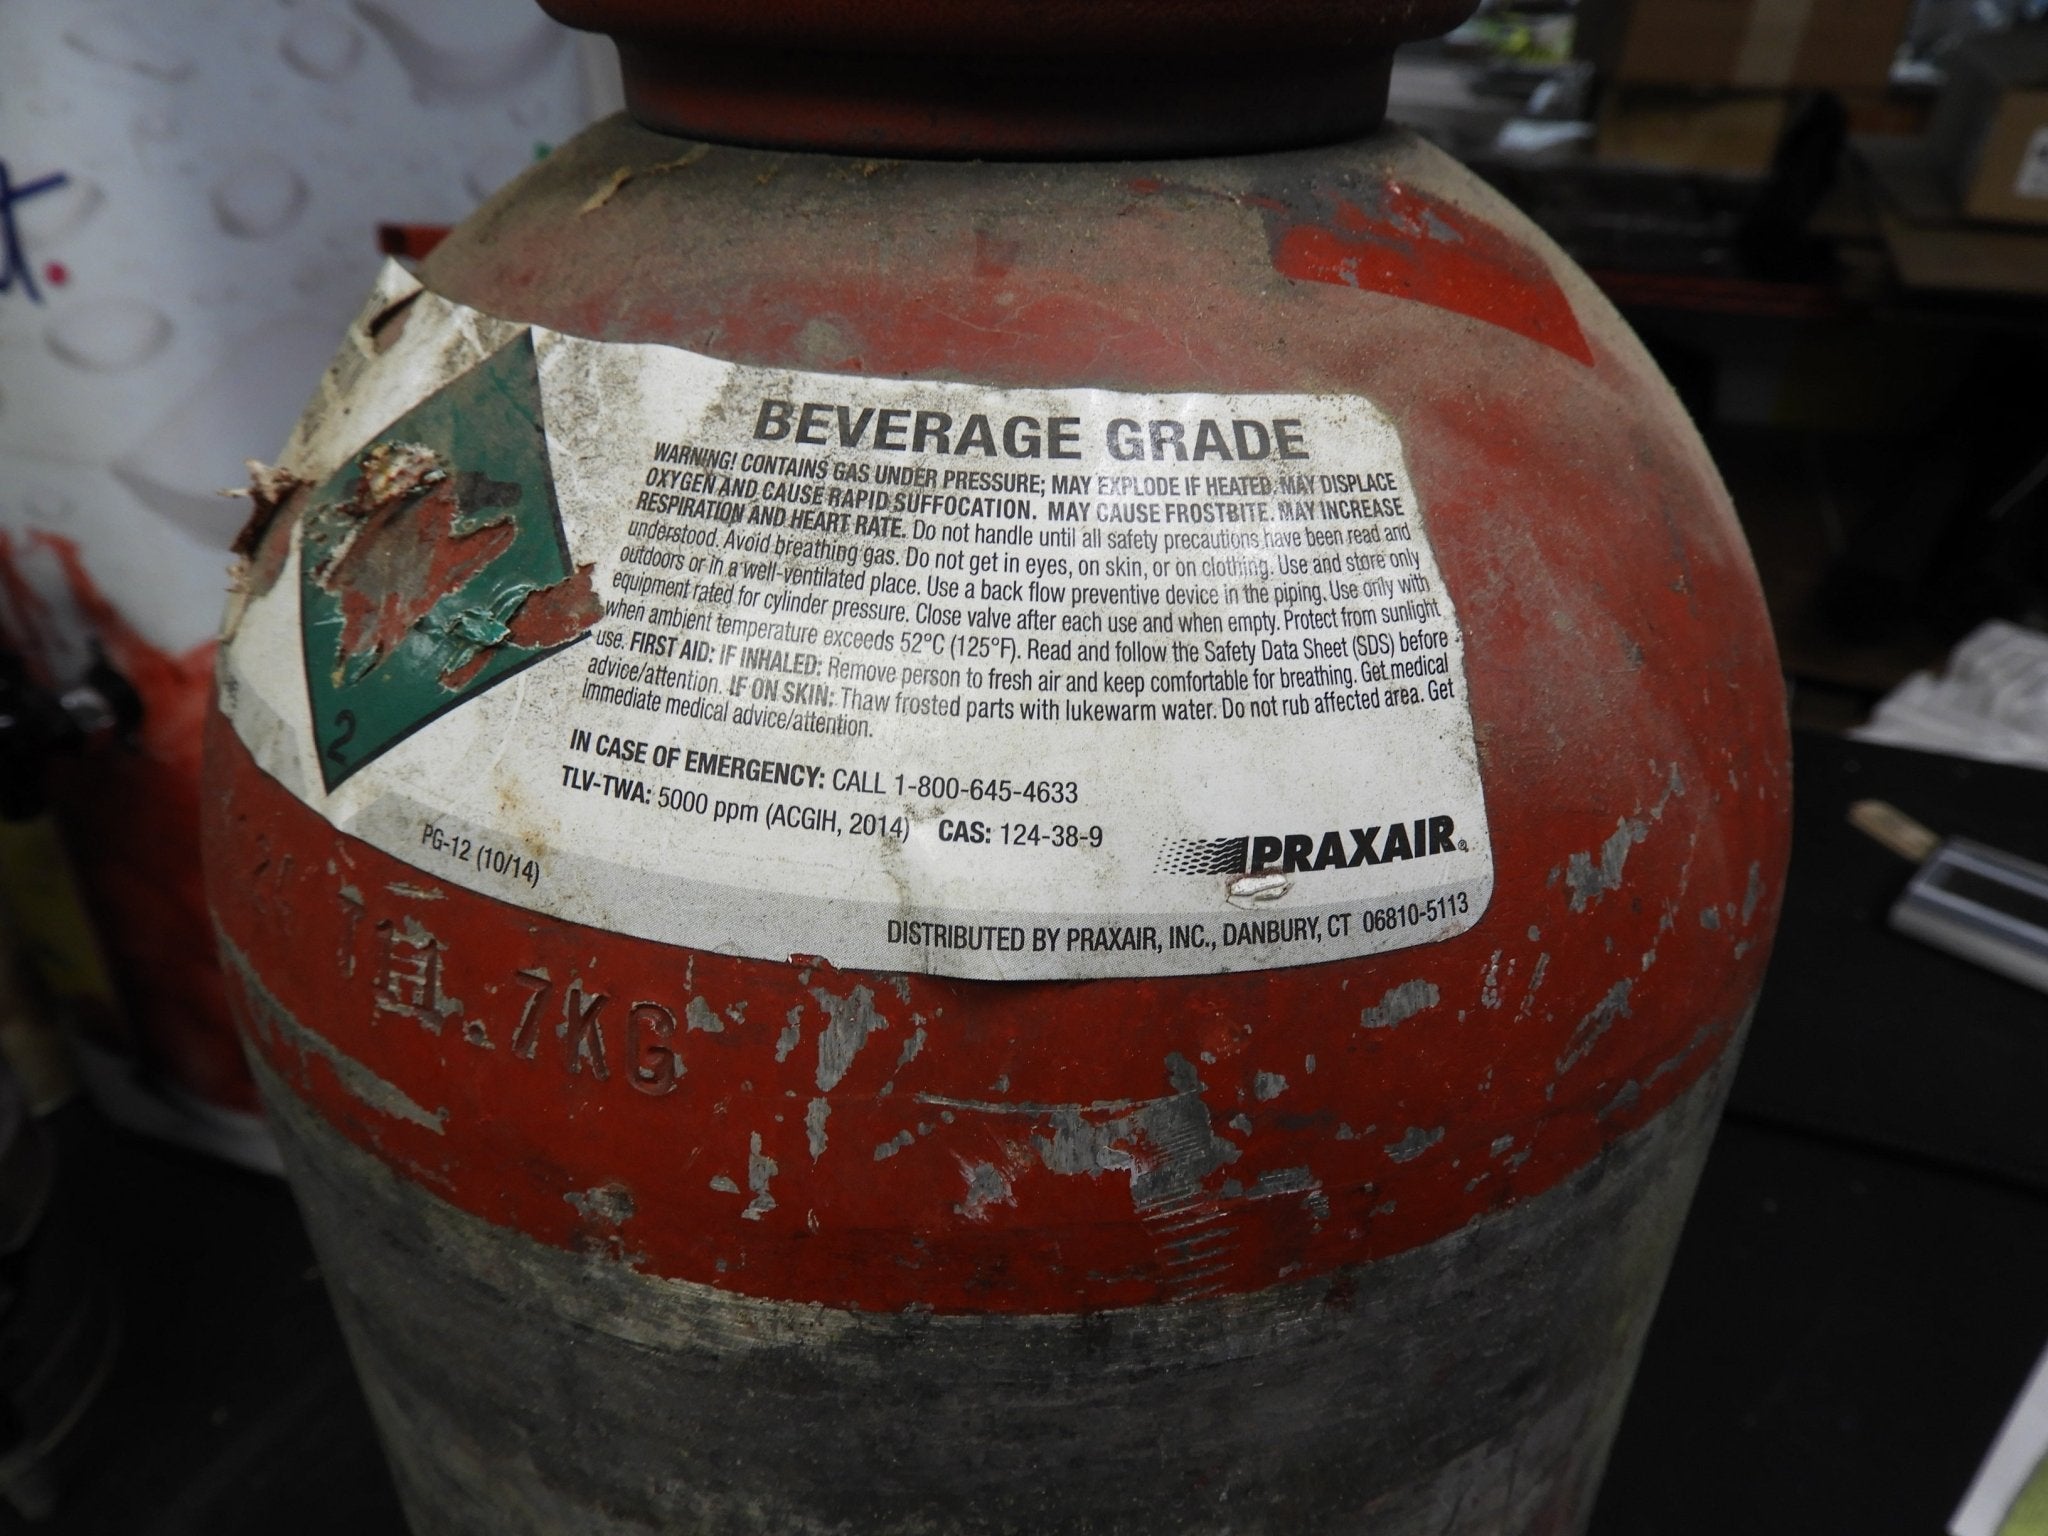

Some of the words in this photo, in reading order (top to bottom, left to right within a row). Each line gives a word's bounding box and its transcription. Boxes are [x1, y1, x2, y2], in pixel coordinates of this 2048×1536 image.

[753, 400, 1082, 459] BEVERAGE
[1105, 417, 1310, 462] GRADE
[644, 466, 714, 494] OXYGEN
[718, 474, 757, 498] AND
[761, 478, 823, 505] CAUSE
[828, 485, 886, 510] RAPID
[891, 490, 1038, 520] SUFFOCATION.
[1047, 499, 1090, 522] MAY
[1096, 501, 1160, 523] CAUSE
[1164, 501, 1275, 523] FROSTBITE.
[1277, 500, 1314, 522] MAY
[1320, 497, 1404, 521] INCREASE
[653, 442, 736, 469] WARNING!
[740, 449, 828, 477] CONTAINS
[832, 457, 869, 481] GAS
[873, 461, 937, 486] UNDER
[942, 466, 1046, 495] PRESSURE;
[1050, 472, 1092, 495] MAY
[1097, 474, 1180, 496] EXPLODE
[1279, 473, 1316, 495] MAY
[1320, 471, 1397, 494] DISPLACE
[627, 520, 719, 550] understood.
[722, 530, 769, 556] Avoid
[773, 536, 857, 569] breathing
[862, 549, 900, 570] gas.
[934, 551, 963, 571] not
[969, 552, 999, 576] get
[1024, 558, 1072, 579] eyes,
[1105, 555, 1148, 580] skin,
[1201, 555, 1273, 581] clothing.
[1277, 554, 1309, 576] Use
[1312, 552, 1341, 575] and
[1346, 552, 1385, 573] store
[1389, 548, 1419, 574] only
[635, 490, 743, 523] RESPIRATION
[747, 504, 784, 528] AND
[789, 508, 849, 534] HEART
[853, 514, 907, 539] RATE.
[941, 523, 969, 543] not
[974, 523, 1033, 546] handle
[1039, 527, 1076, 548] until
[1081, 527, 1101, 549] all
[1107, 528, 1158, 554] safety
[1163, 529, 1259, 555] precautions
[1263, 528, 1301, 549] have
[1305, 527, 1343, 548] been
[1346, 524, 1380, 546] read
[1383, 522, 1411, 544] and
[611, 575, 690, 601] equipment
[692, 583, 733, 605] rated
[737, 585, 759, 608] for
[763, 590, 828, 615] cylinder
[831, 600, 910, 623] pressure.
[914, 602, 961, 626] Close
[966, 607, 1011, 629] valve
[1016, 609, 1055, 631] after
[1061, 611, 1102, 633] each
[1107, 617, 1137, 633] use
[1142, 612, 1173, 633] and
[1177, 612, 1223, 633] when
[1227, 611, 1280, 636] empty.
[1284, 608, 1337, 630] Protect
[1340, 606, 1377, 627] from
[1381, 600, 1441, 626] sunlight
[619, 546, 684, 571] outdoors
[742, 560, 866, 592] well-ventilated
[869, 572, 921, 597] place.
[926, 576, 959, 599] Use
[980, 579, 1023, 602] back
[1027, 581, 1064, 604] flow
[1070, 585, 1160, 609] preventive
[1165, 584, 1219, 606] device
[1243, 583, 1268, 604] the
[1273, 582, 1327, 608] piping.
[1328, 580, 1358, 601] Use
[1362, 577, 1394, 603] only
[1396, 575, 1430, 598] with
[595, 631, 626, 650] use.
[628, 630, 679, 656] FIRST
[683, 636, 715, 661] AID:
[740, 643, 822, 673] INHALED:
[827, 654, 896, 681] Remove
[900, 666, 961, 687] person
[987, 667, 1033, 690] fresh
[1037, 670, 1061, 691] air
[1065, 670, 1098, 692] and
[1103, 670, 1145, 696] keep
[1150, 668, 1249, 691] comfortable
[1253, 667, 1275, 688] for
[1279, 663, 1358, 687] breathing.
[1360, 660, 1388, 682] Get
[1390, 655, 1448, 680] medical
[604, 599, 645, 623] when
[648, 606, 712, 633] ambient
[716, 614, 818, 645] temperature
[822, 629, 894, 651] exceeds
[1026, 638, 1071, 661] Read
[1076, 640, 1109, 662] and
[1114, 640, 1167, 662] follow
[1171, 641, 1199, 662] the
[1203, 640, 1255, 666] Safety
[1261, 639, 1298, 661] Data
[1303, 637, 1348, 659] Sheet
[1351, 633, 1395, 661] (SDS)
[1399, 631, 1448, 654] before
[580, 680, 661, 713] immediate
[664, 696, 729, 723] medical
[732, 704, 874, 736] advice/attention.
[586, 656, 720, 694] advice/attention.
[750, 677, 778, 700] ON
[782, 681, 834, 706] SKIN:
[840, 686, 889, 711] Thaw
[894, 691, 960, 716] frosted
[965, 698, 1014, 722] parts
[1019, 699, 1060, 721] with
[1064, 700, 1157, 722] lukewarm
[1161, 701, 1219, 721] water.
[1249, 697, 1279, 719] not
[1281, 694, 1310, 717] rub
[1314, 688, 1380, 715] affected
[1383, 690, 1424, 709] area.
[1426, 681, 1454, 704] Get
[327, 709, 357, 766] 2
[569, 728, 592, 753] IN
[595, 733, 648, 764] CASE
[652, 745, 681, 769] OF
[685, 749, 826, 790] EMERGENCY:
[833, 768, 886, 795] CALL
[895, 774, 1079, 804] 1-800-645-4633
[562, 765, 651, 805] TLV-TWA:
[657, 787, 708, 815] 5000
[714, 800, 759, 823] ppm
[765, 803, 842, 836] (ACGIH,
[849, 812, 910, 843] 2014)
[938, 819, 991, 845] CAS:
[1001, 823, 1103, 848] 124-38-9
[422, 823, 472, 862] PG-12
[477, 845, 540, 888] (10/14)
[888, 919, 1025, 952] DISTRIBUTED
[1032, 927, 1060, 952] BY
[1066, 926, 1162, 953] PRAXAIR,
[1169, 924, 1217, 951] INC.,
[1223, 917, 1322, 946] DANBURY,
[1328, 913, 1351, 938] CT
[1363, 891, 1469, 934] 06810-5113
